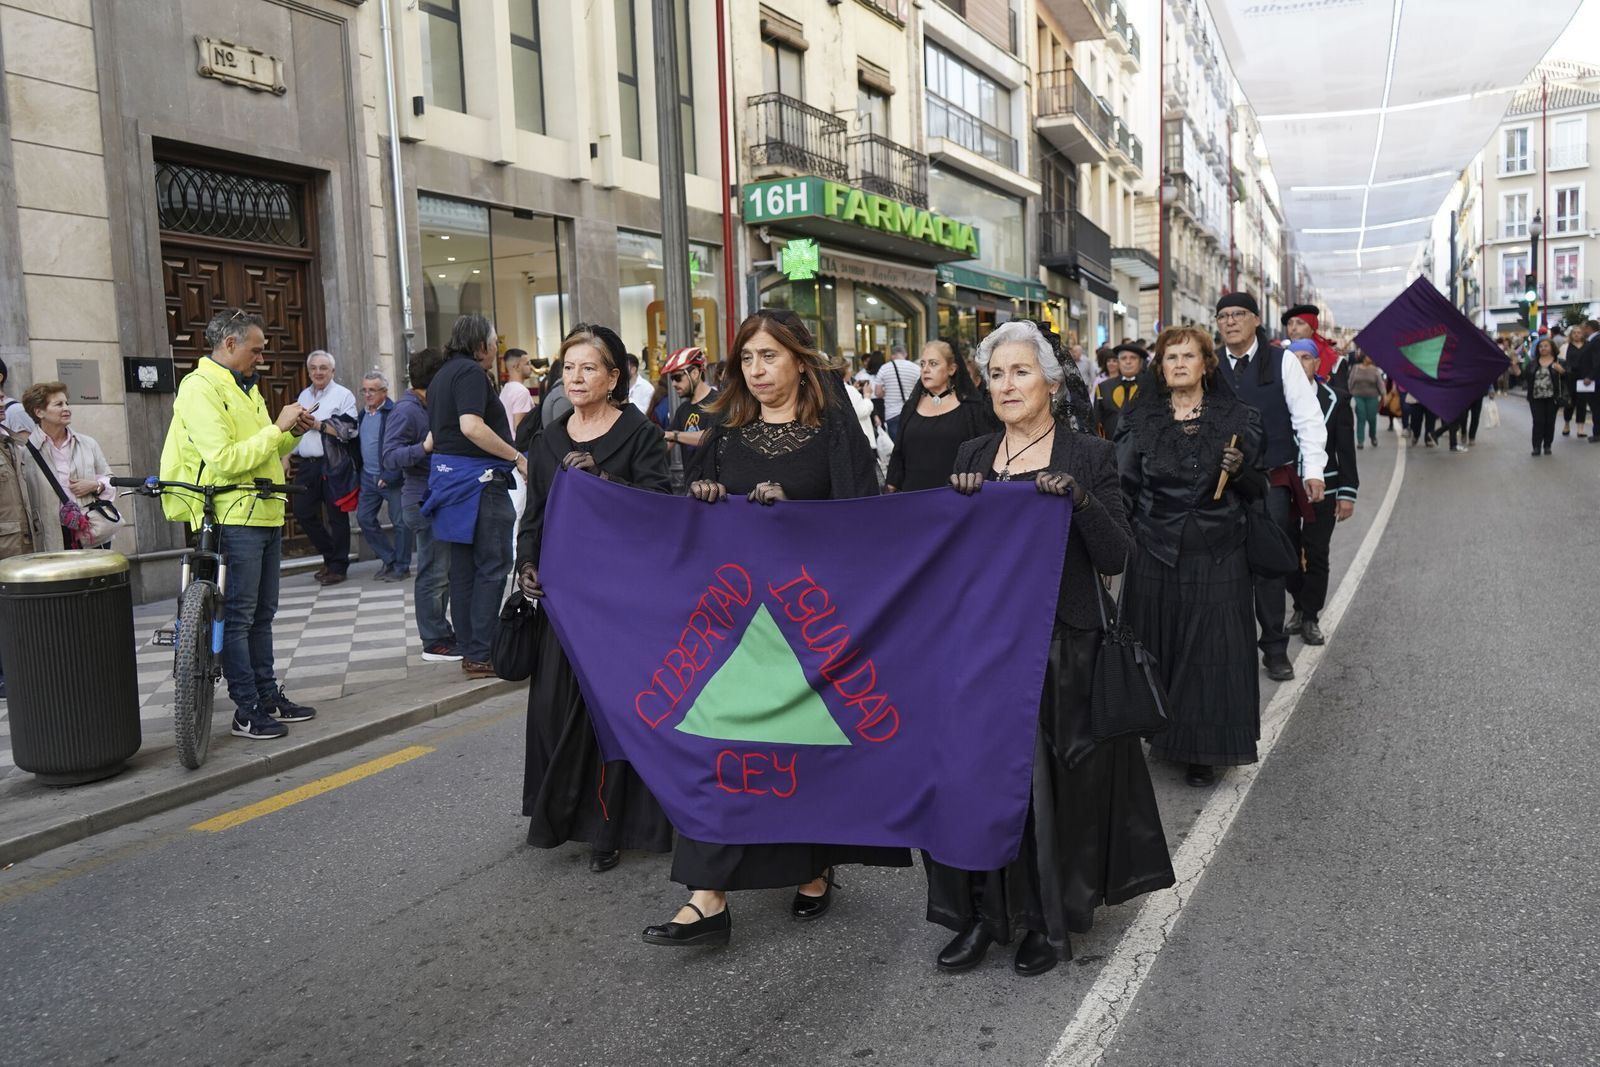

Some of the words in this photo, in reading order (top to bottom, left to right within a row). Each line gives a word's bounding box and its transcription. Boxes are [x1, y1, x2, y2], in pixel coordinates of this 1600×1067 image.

[250, 57, 256, 75] 1
[750, 182, 808, 217] 16H
[824, 181, 978, 254] FARMACIA
[767, 564, 899, 742] IGUALDAD
